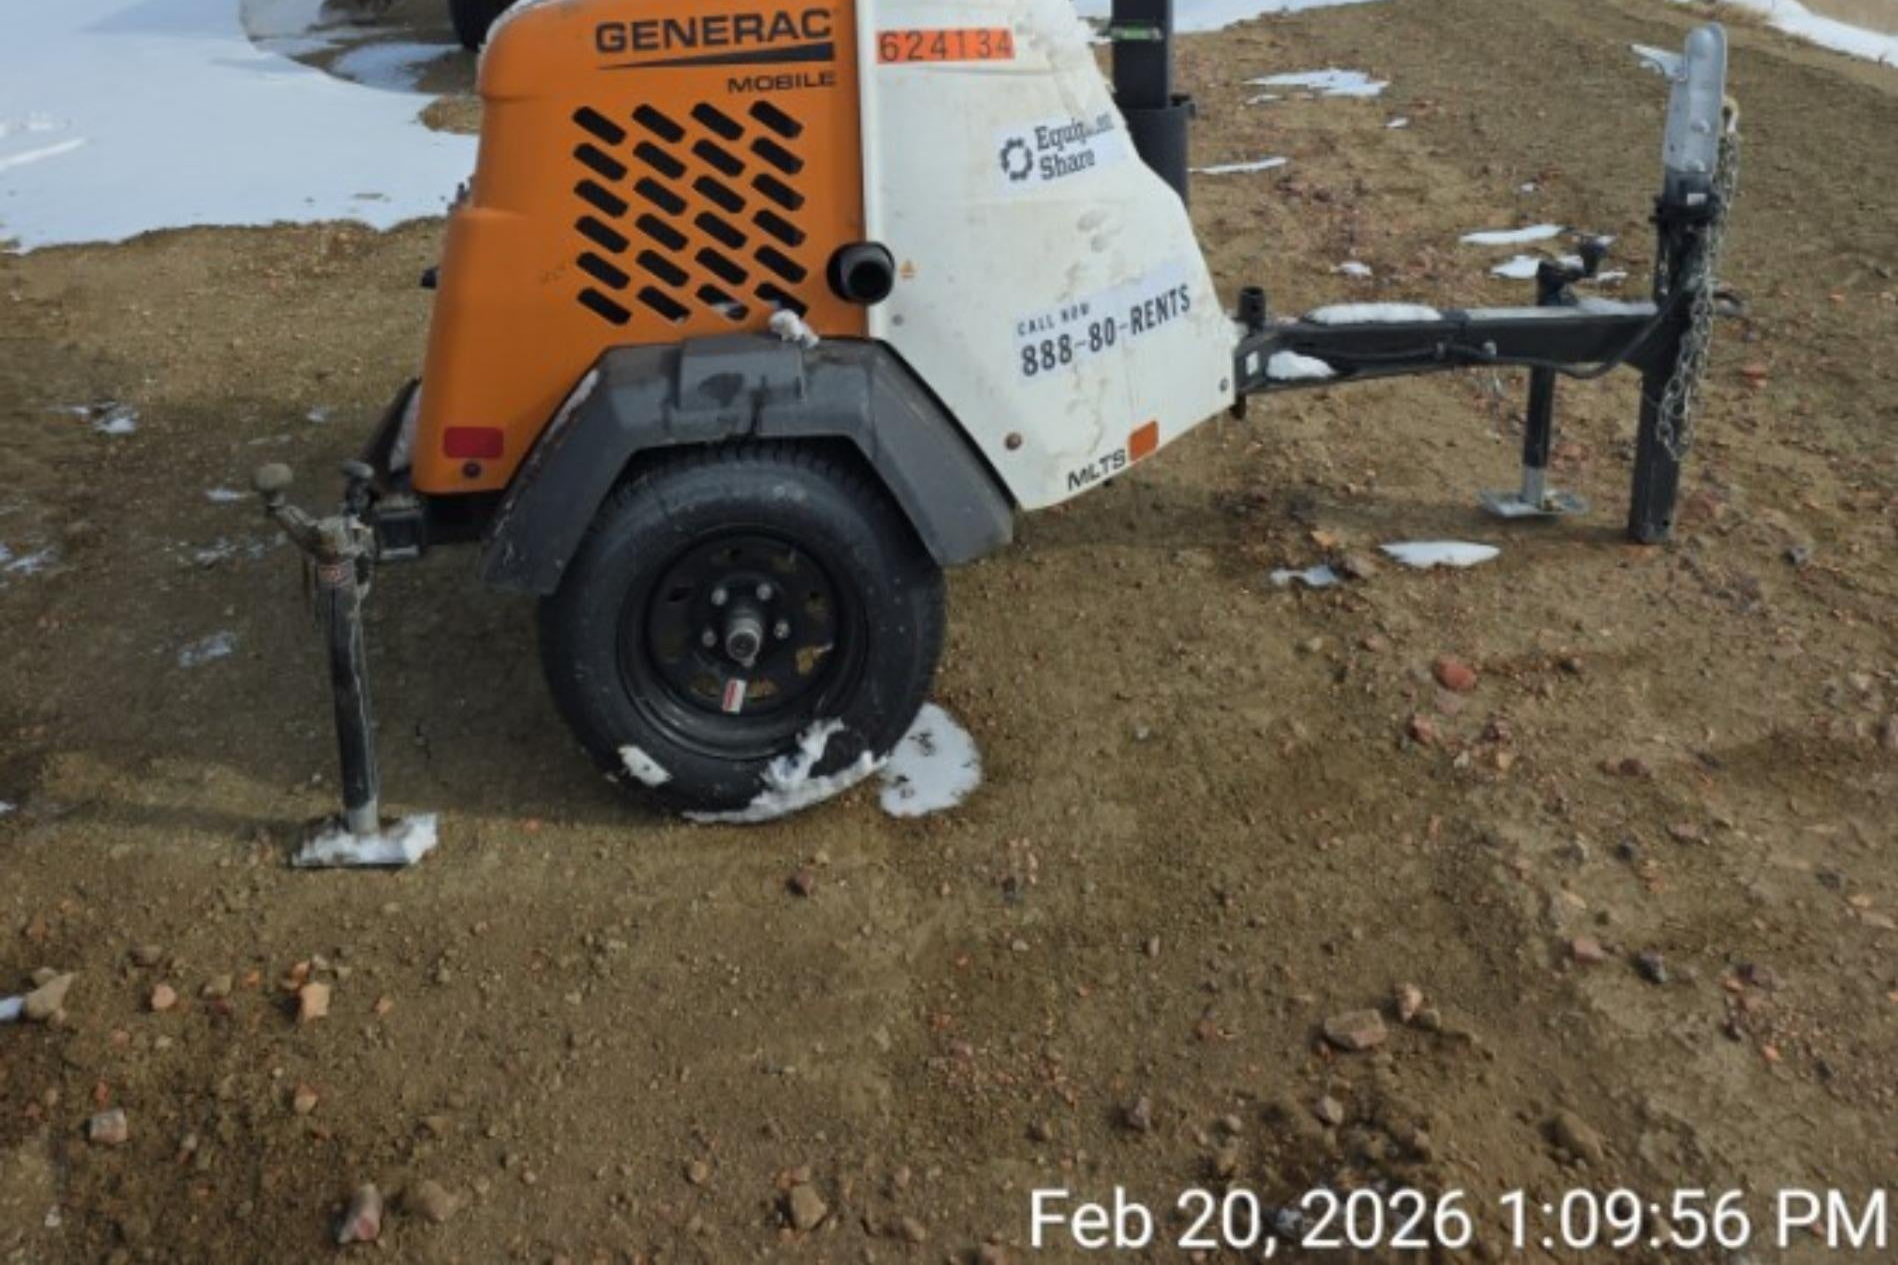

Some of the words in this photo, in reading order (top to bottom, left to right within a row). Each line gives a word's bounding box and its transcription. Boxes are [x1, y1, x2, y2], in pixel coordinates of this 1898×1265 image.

[595, 8, 833, 53] GENERAC
[727, 72, 837, 93] MOBILE
[1039, 149, 1096, 180] Share
[1017, 315, 1054, 336] CALL
[1021, 283, 1191, 377] 888-80-RENTS
